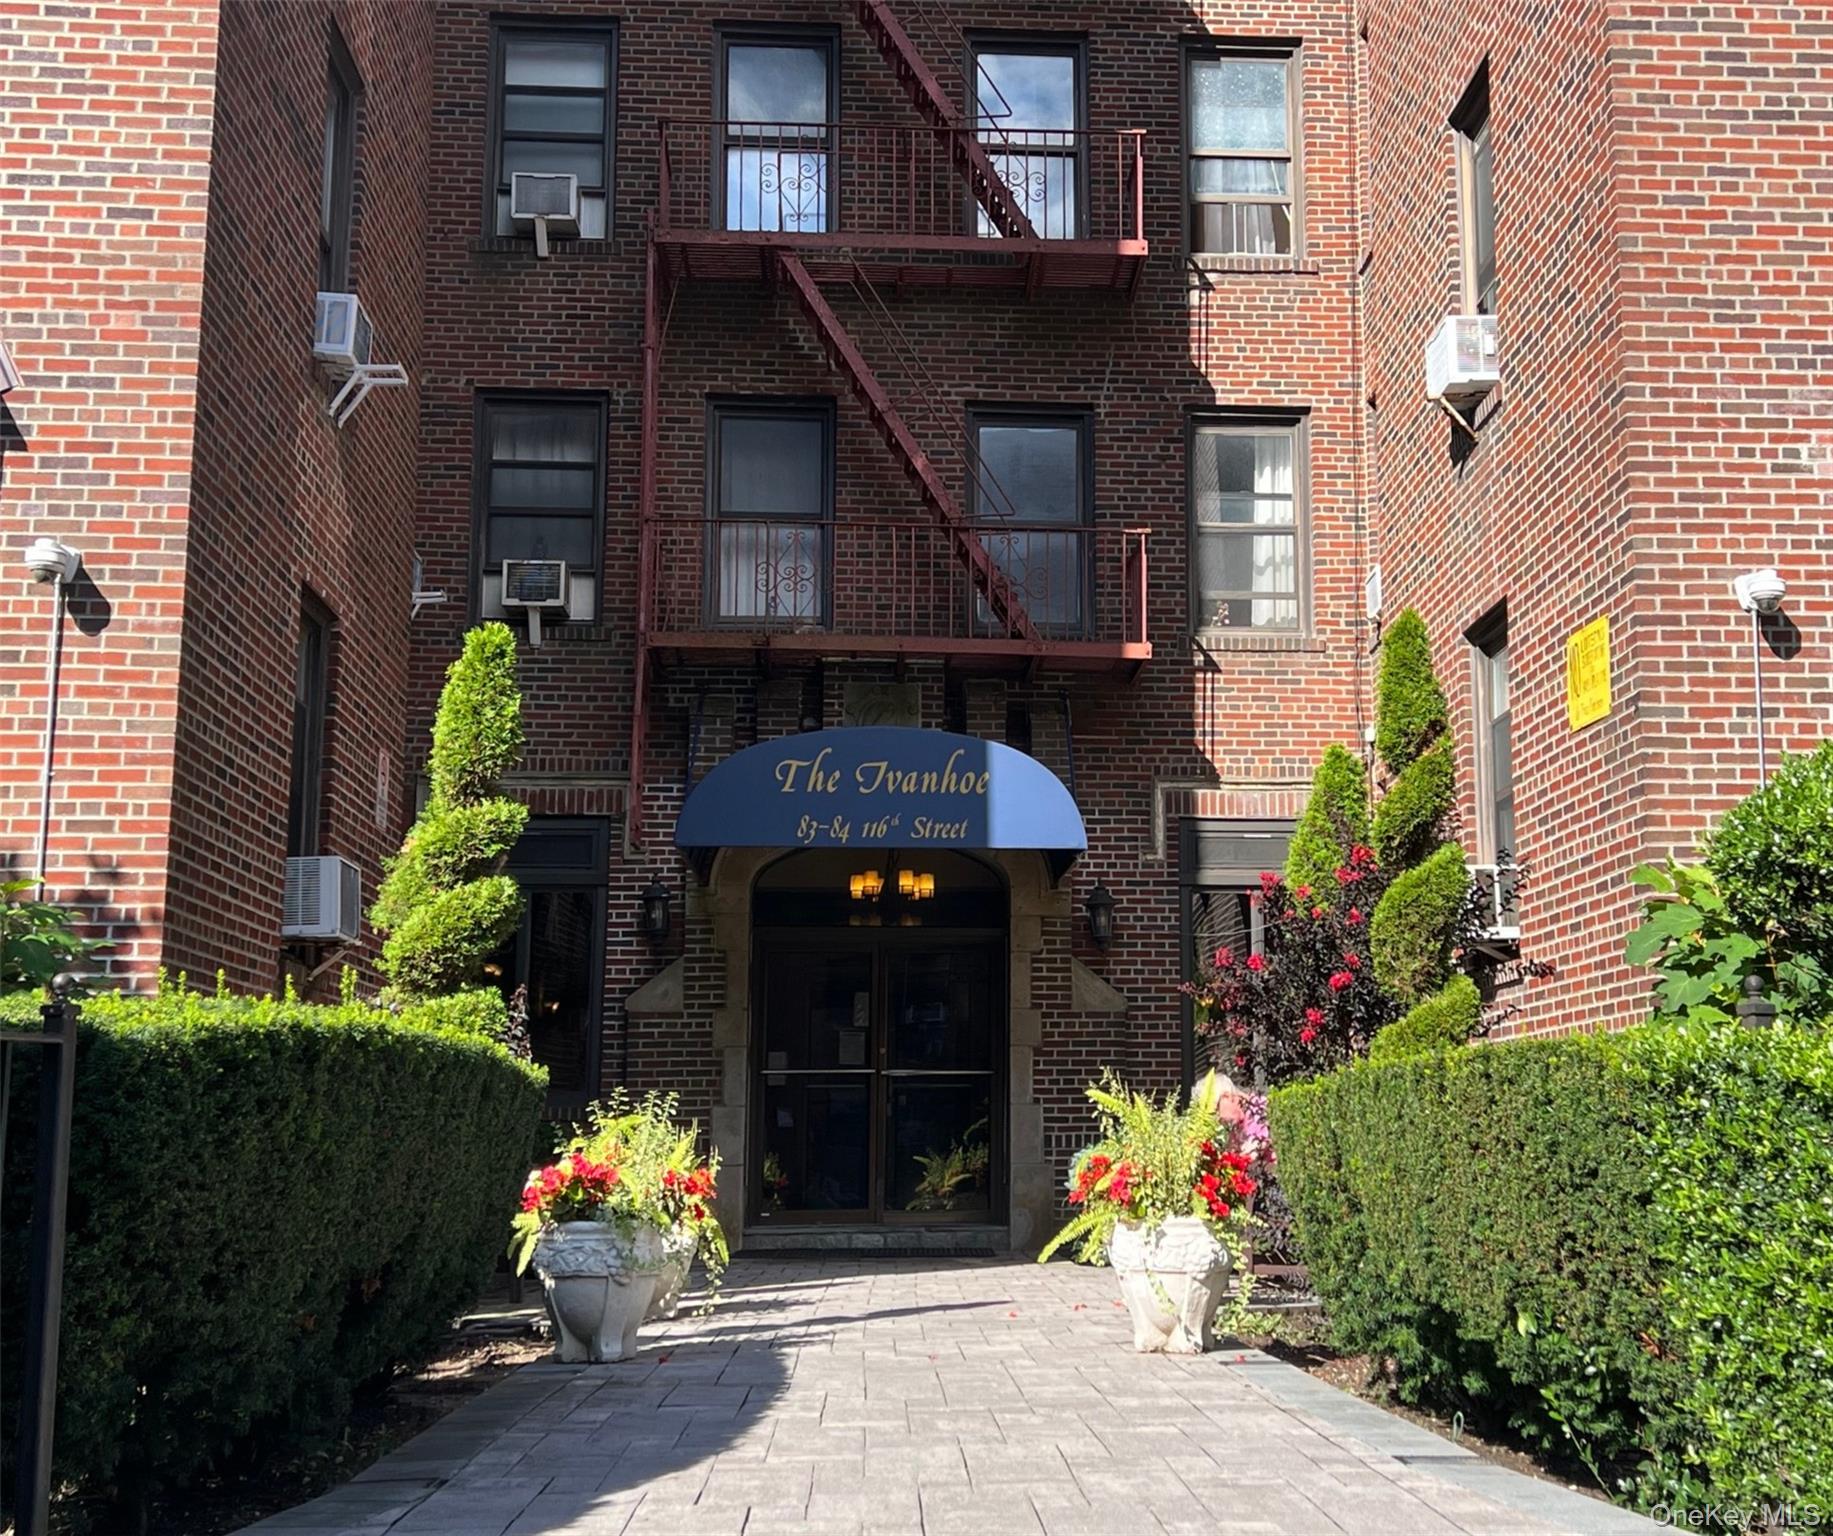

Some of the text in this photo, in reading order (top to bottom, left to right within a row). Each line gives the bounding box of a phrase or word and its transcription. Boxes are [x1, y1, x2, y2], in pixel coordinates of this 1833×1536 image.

[775, 747, 989, 794] The Ivanhoe
[796, 814, 851, 845] 83-84
[910, 816, 969, 840] Street
